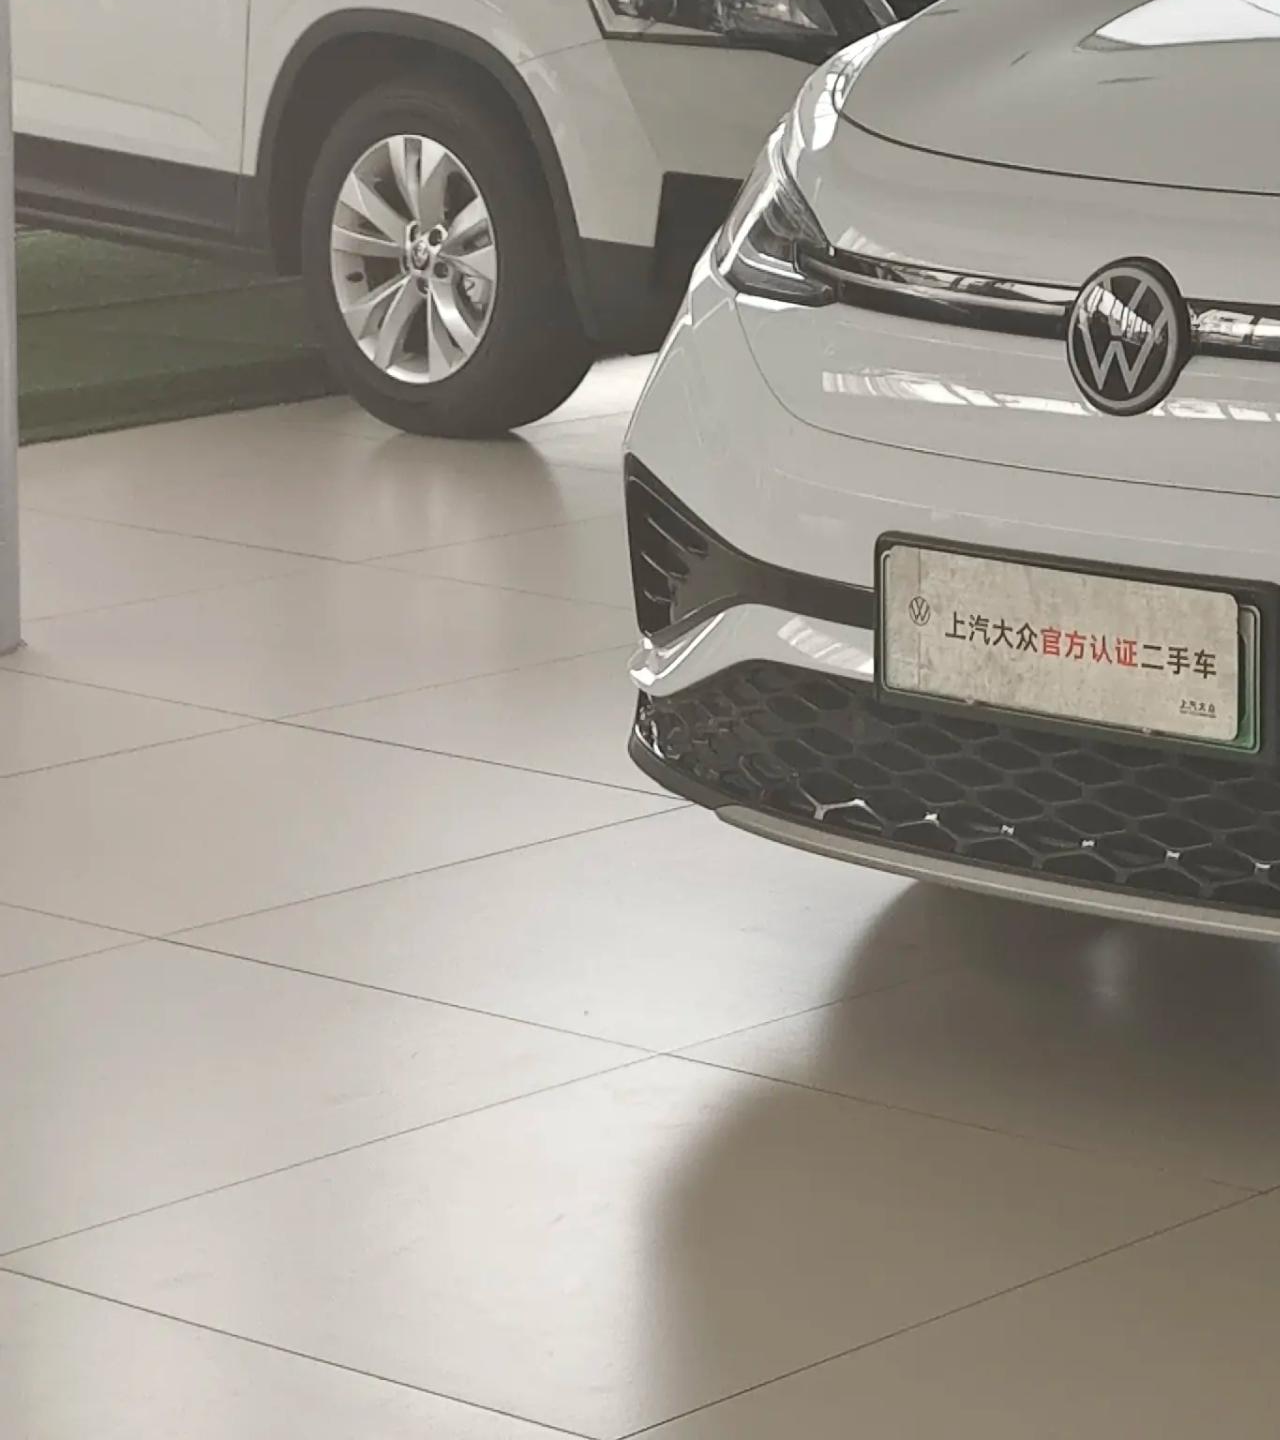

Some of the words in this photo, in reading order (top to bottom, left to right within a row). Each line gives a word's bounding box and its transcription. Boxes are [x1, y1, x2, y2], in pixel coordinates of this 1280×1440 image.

[944, 611, 1218, 680] 上汽大众官方认证二手车
